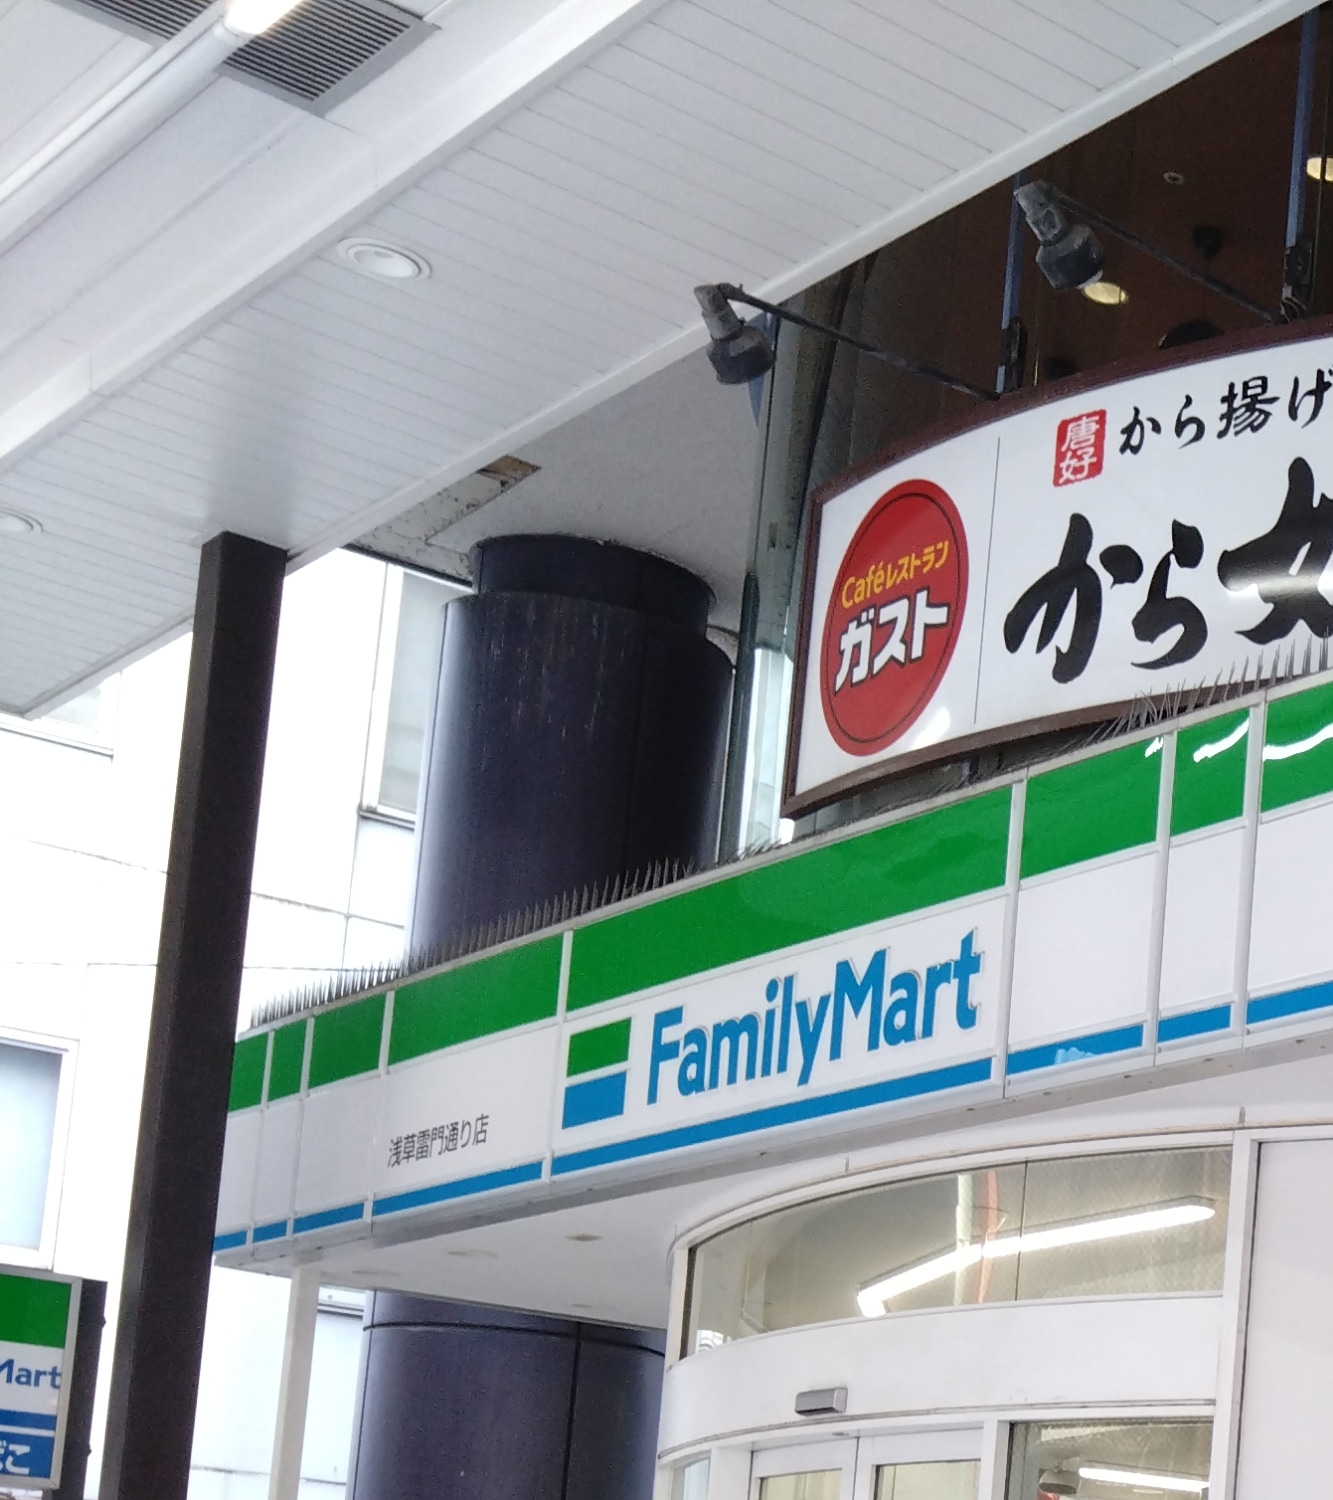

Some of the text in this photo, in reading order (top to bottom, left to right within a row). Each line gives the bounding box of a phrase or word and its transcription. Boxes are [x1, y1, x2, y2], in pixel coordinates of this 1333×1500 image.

[1058, 414, 1100, 485] 唐好
[834, 587, 950, 694] ガスト
[646, 926, 986, 1106] FamilyMart
[386, 1113, 490, 1168] 浅草雷門通り店
